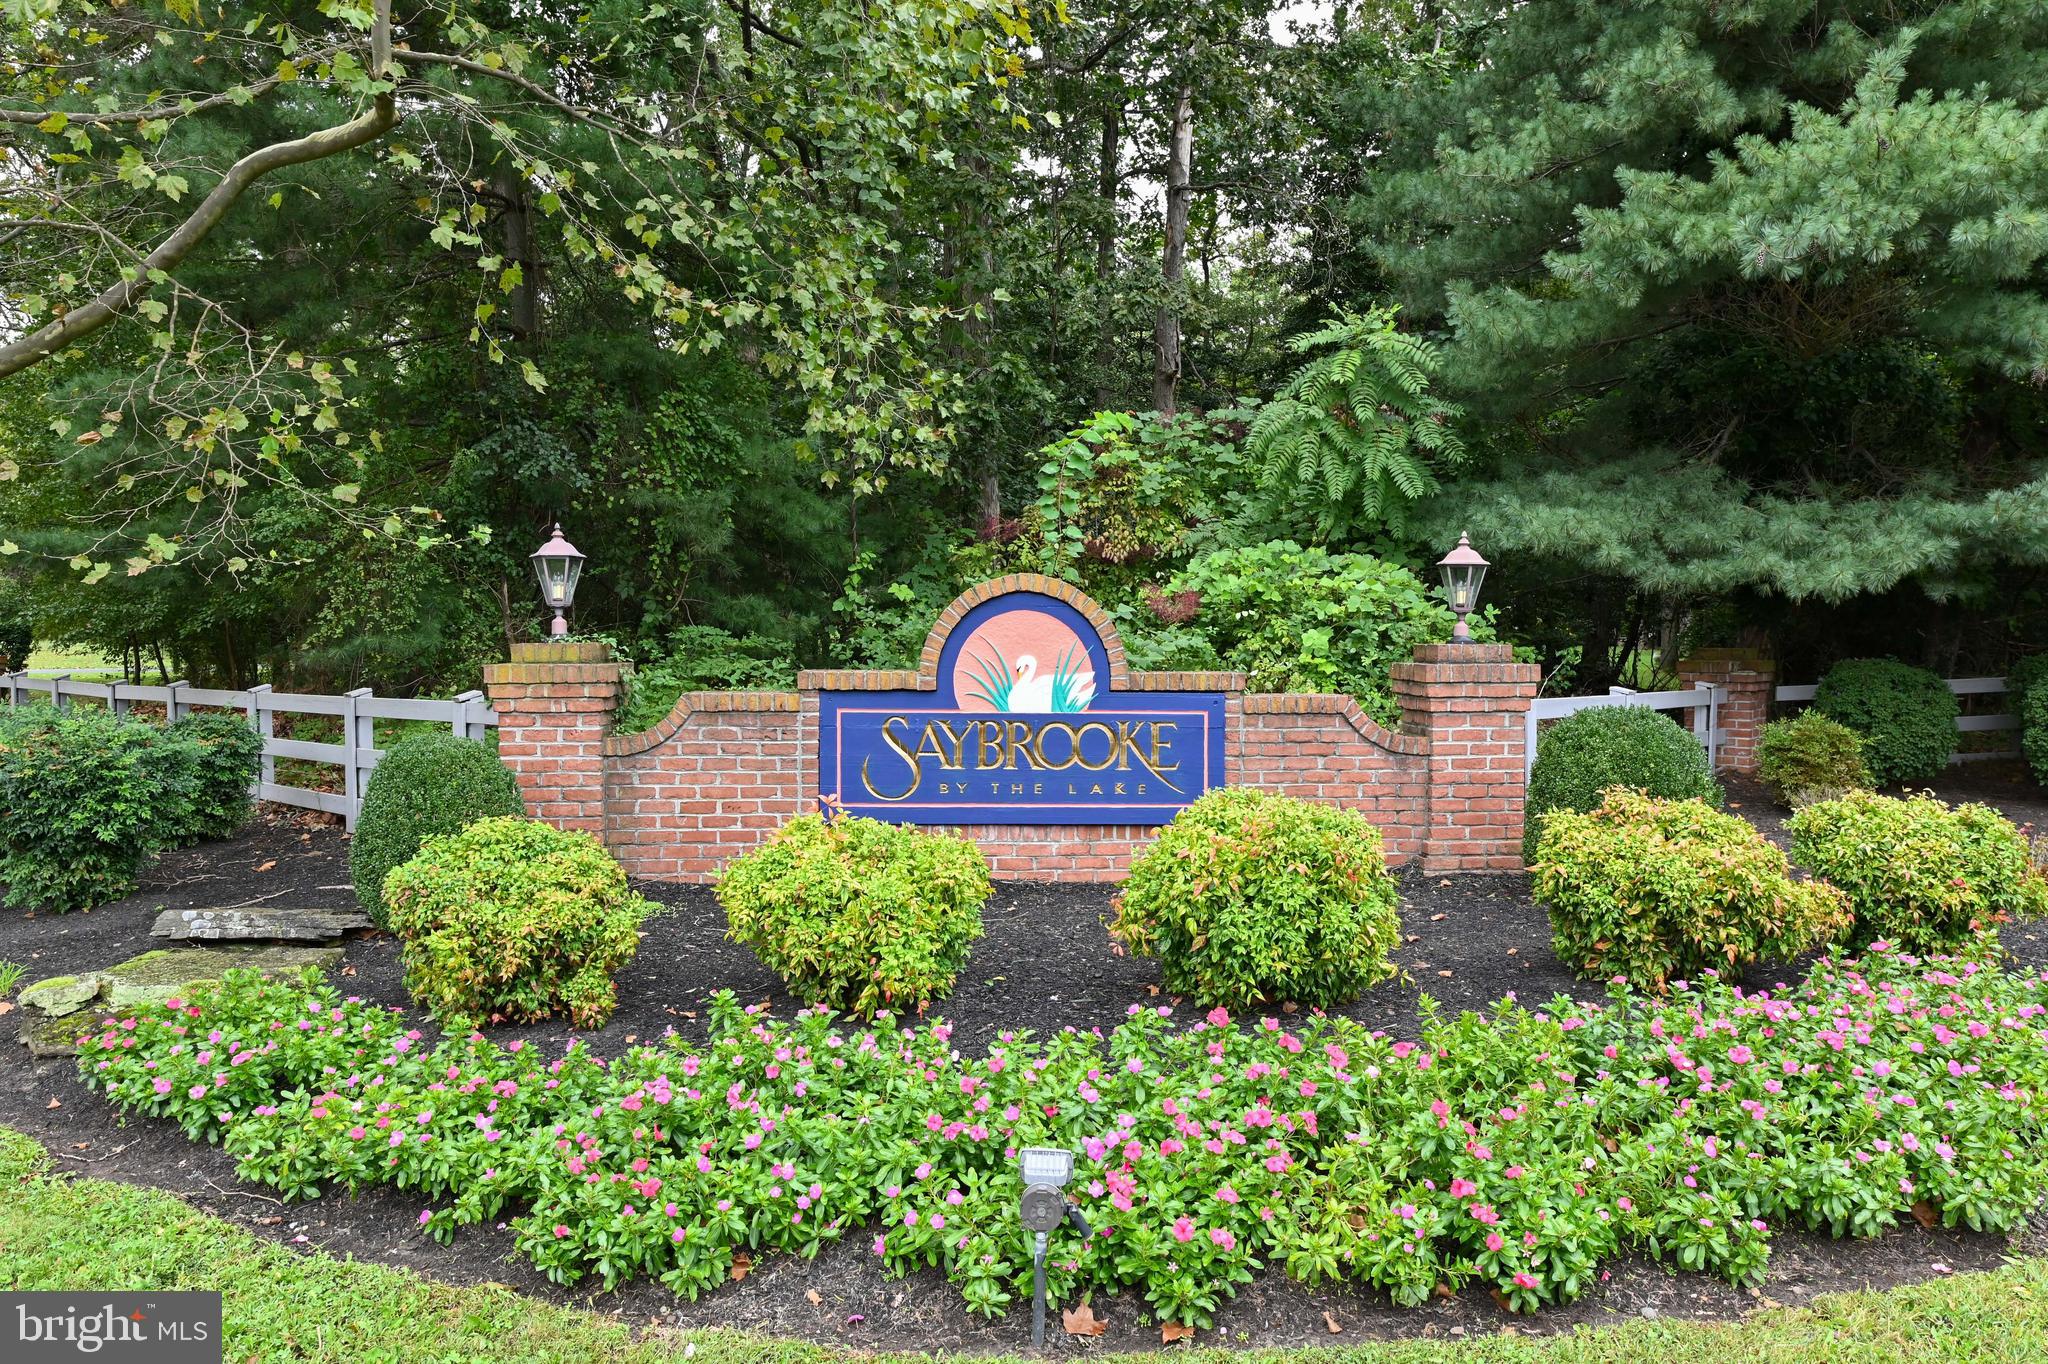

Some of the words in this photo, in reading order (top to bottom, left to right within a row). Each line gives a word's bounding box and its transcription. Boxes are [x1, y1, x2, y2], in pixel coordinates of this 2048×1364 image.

[862, 716, 1185, 801] SAYBROOKE
[939, 783, 967, 795] BY
[992, 783, 1043, 795] THE
[1068, 783, 1147, 795] LAKE
